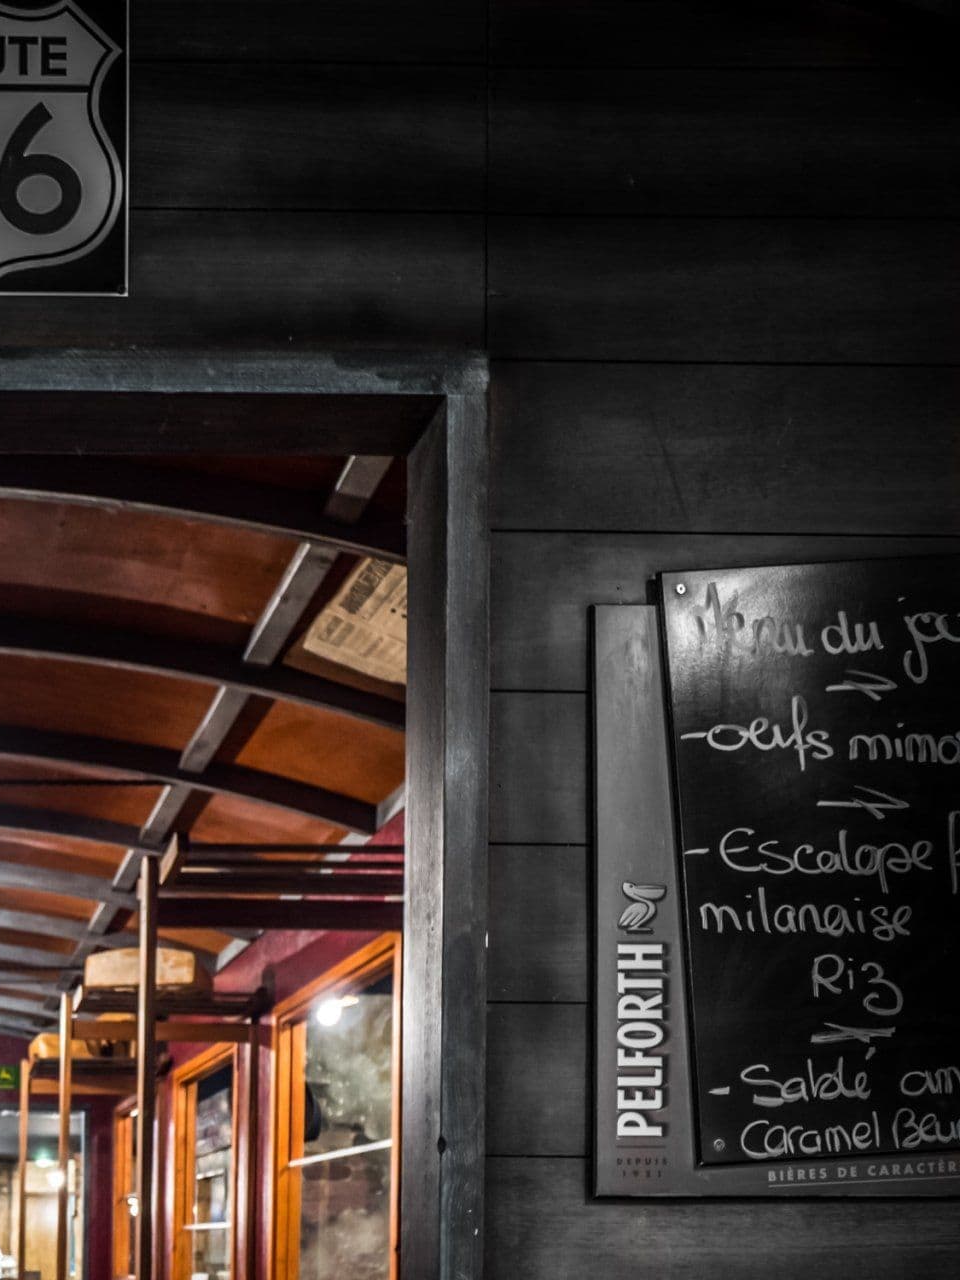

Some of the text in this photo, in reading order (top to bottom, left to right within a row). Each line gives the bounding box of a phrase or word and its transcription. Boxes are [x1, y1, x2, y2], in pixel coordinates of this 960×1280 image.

[821, 611, 884, 655] du
[848, 722, 960, 765] mimo
[719, 827, 934, 894] Escalope
[699, 886, 913, 941] milanaise
[811, 954, 904, 1016] Riz
[616, 943, 664, 1137] PELFORTH
[740, 1111, 881, 1159] Caramel
[768, 1167, 827, 1182] BIÈRES
[837, 1166, 858, 1178] DE
